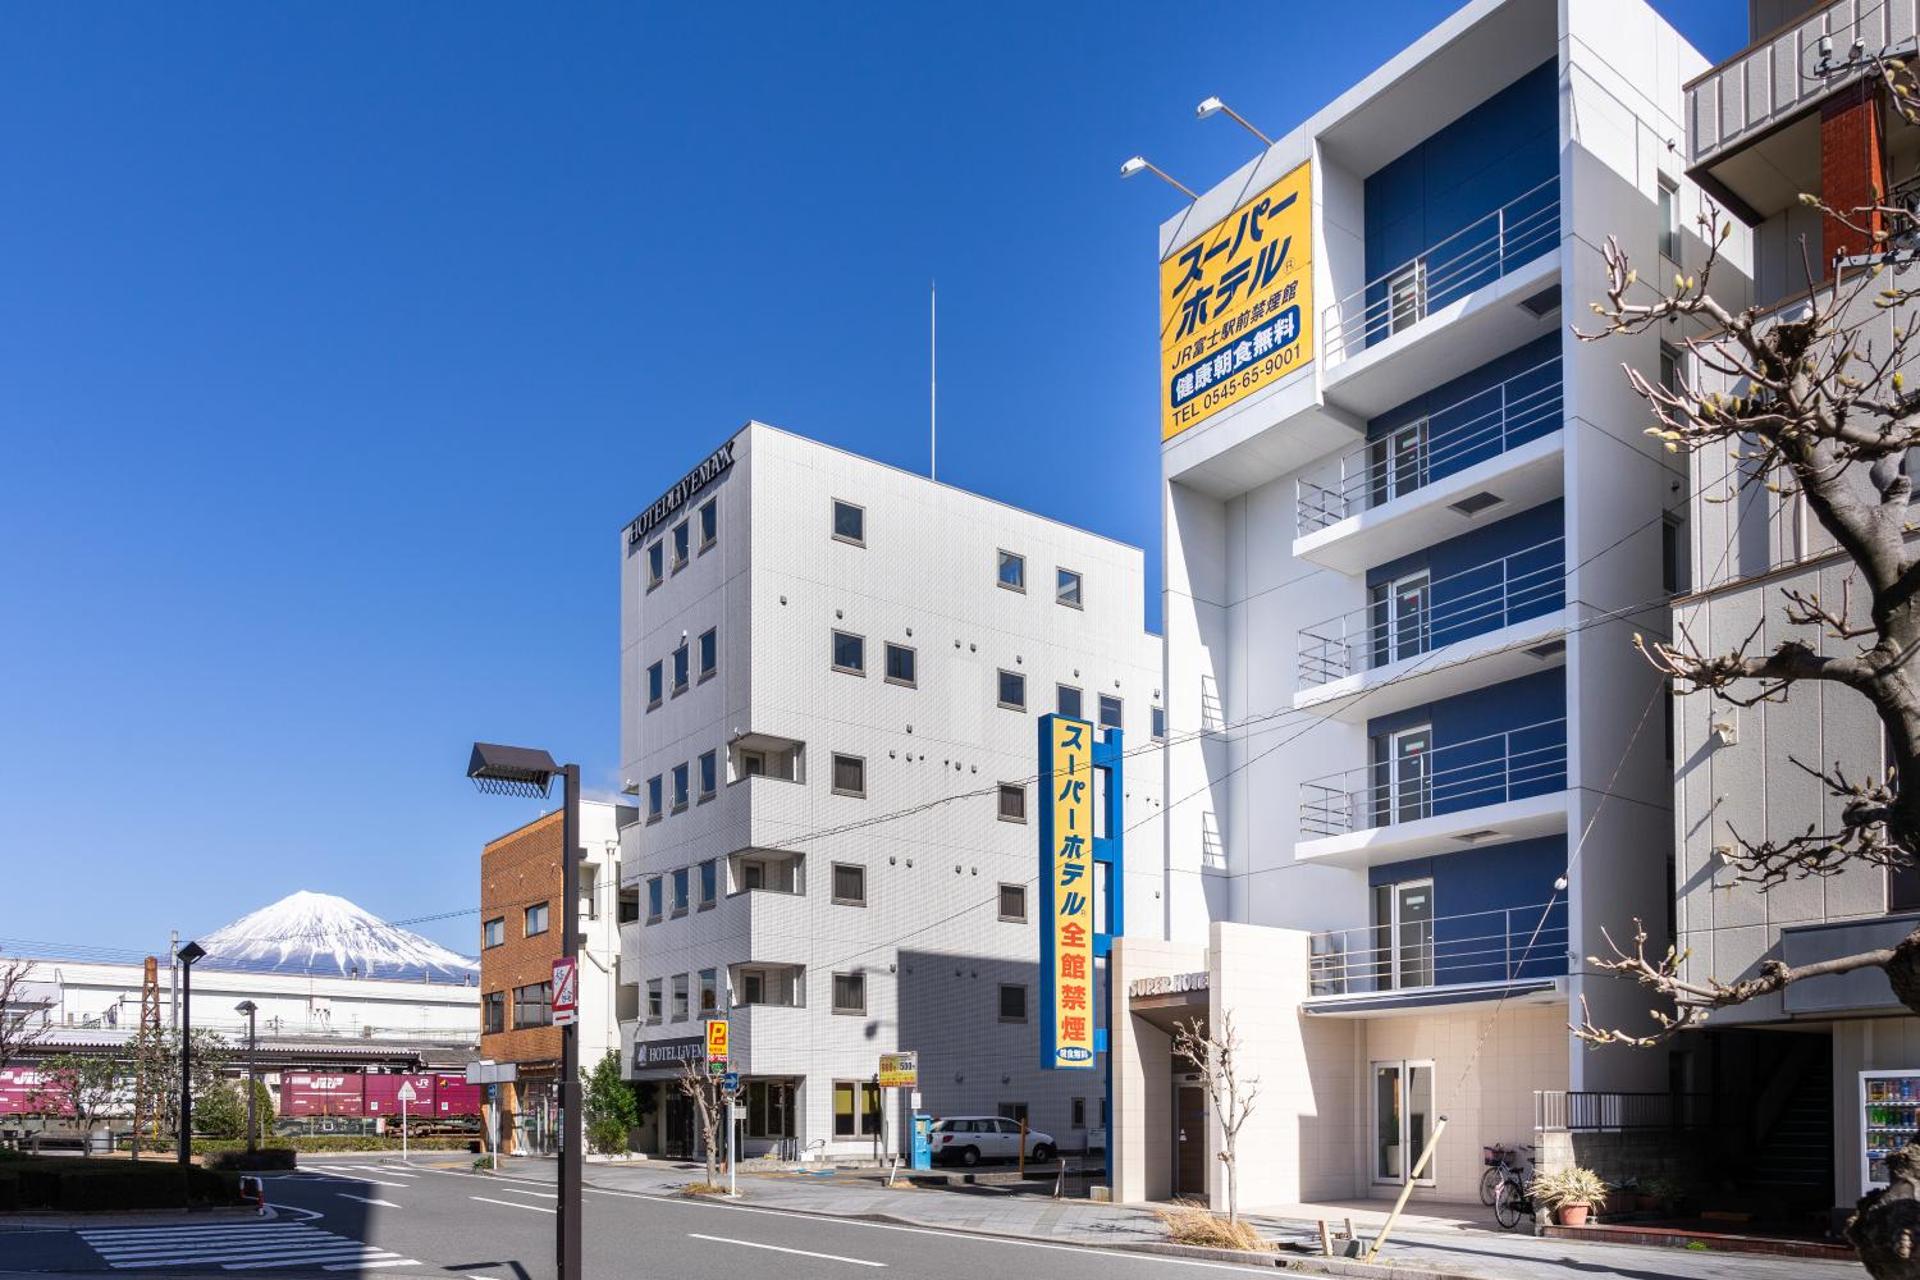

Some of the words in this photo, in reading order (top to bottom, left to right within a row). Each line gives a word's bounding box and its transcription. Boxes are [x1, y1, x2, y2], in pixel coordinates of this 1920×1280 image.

[1172, 191, 1299, 298] スーパー
[1175, 235, 1293, 343] ホテル
[1172, 279, 1300, 370] JR富士駅前禁煙館
[1175, 313, 1296, 403] 健康朝食無料
[1172, 403, 1200, 427] TEL
[1203, 343, 1301, 410] 0545-65-9001
[630, 496, 670, 544] HOTEL
[1059, 725, 1086, 916] スーパーホテル
[1060, 922, 1087, 1042] 全館禁煙
[1130, 976, 1171, 997] SUPER
[1173, 971, 1210, 992] HOTE
[415, 1078, 429, 1087] JR
[649, 1046, 677, 1062] HOTEL
